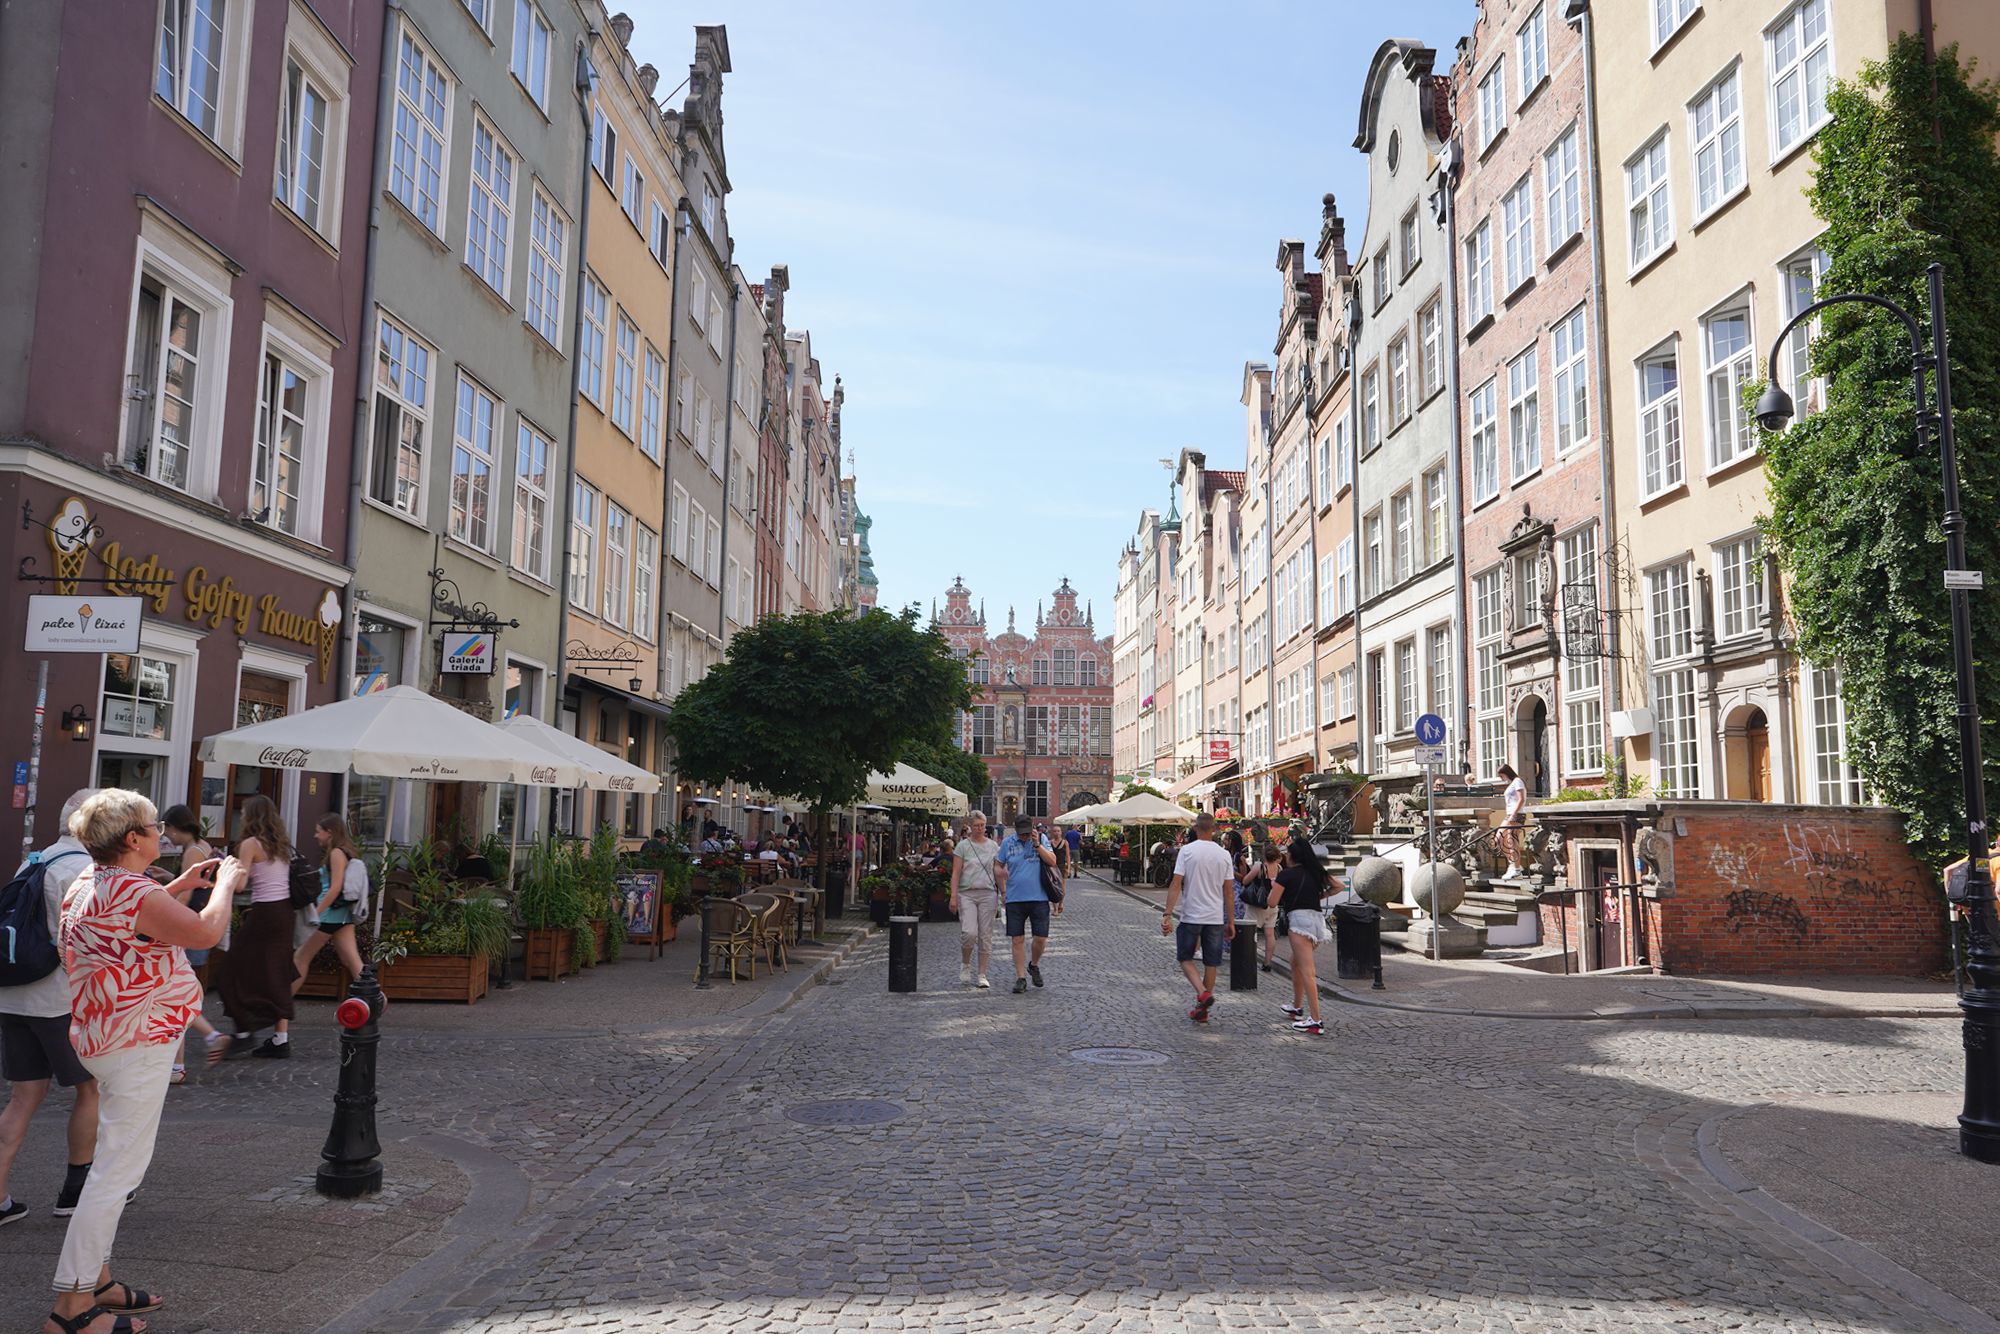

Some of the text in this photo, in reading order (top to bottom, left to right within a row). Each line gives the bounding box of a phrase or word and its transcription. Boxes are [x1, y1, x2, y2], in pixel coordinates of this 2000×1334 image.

[101, 542, 318, 646] Lody Gofry Kawa
[41, 617, 125, 631] palce lizać
[449, 655, 485, 664] Galeria
[882, 784, 927, 795] KSIĄŻĘCE
